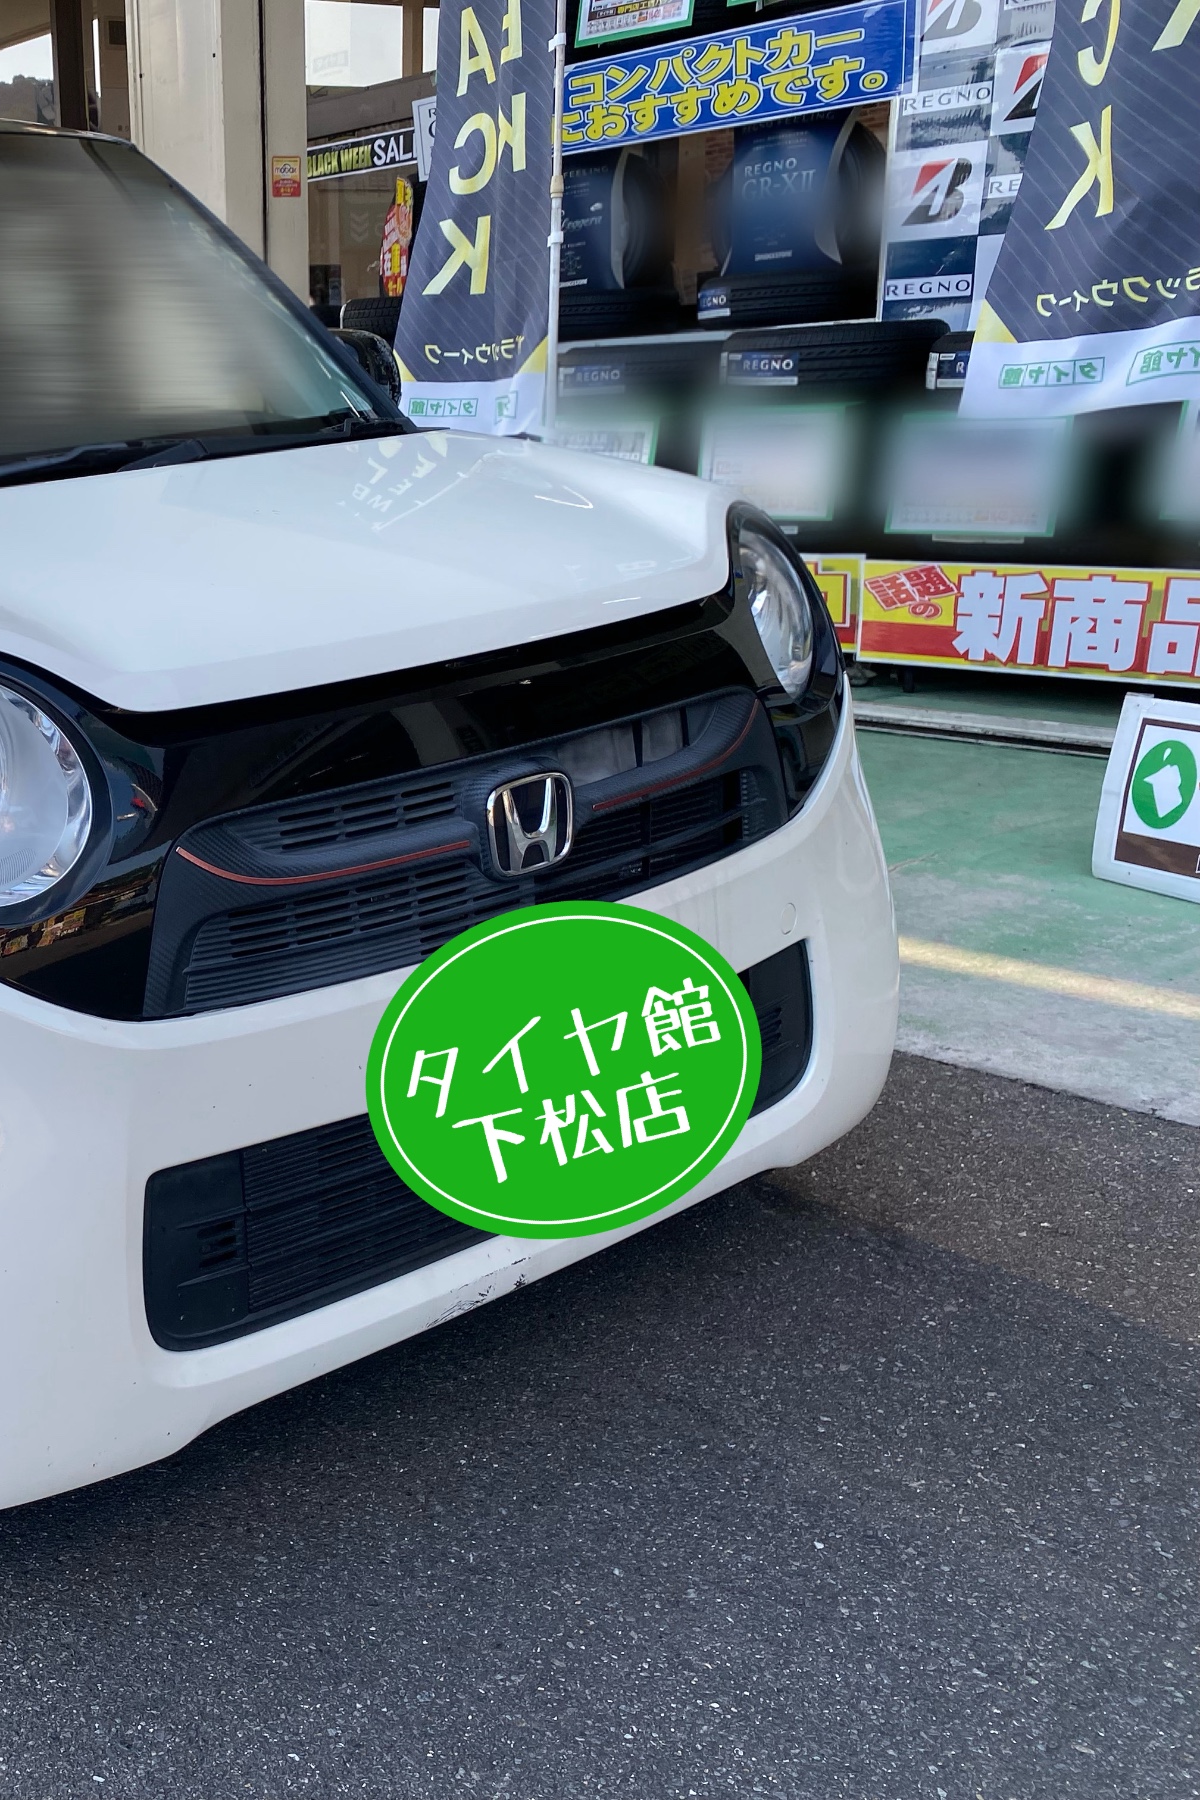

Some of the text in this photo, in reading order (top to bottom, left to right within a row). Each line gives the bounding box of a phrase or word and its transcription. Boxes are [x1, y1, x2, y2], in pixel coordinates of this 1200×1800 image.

[571, 29, 863, 106] コンパクトカー
[552, 57, 887, 144] におすすめです。
[903, 86, 991, 111] REGNO
[307, 151, 340, 177] BLACK
[340, 145, 373, 172] WEEK
[745, 158, 798, 178] REGNO
[886, 279, 971, 298] REGNO
[702, 295, 727, 307] EGNO
[743, 359, 793, 371] REGNO
[576, 370, 620, 382] REGNO
